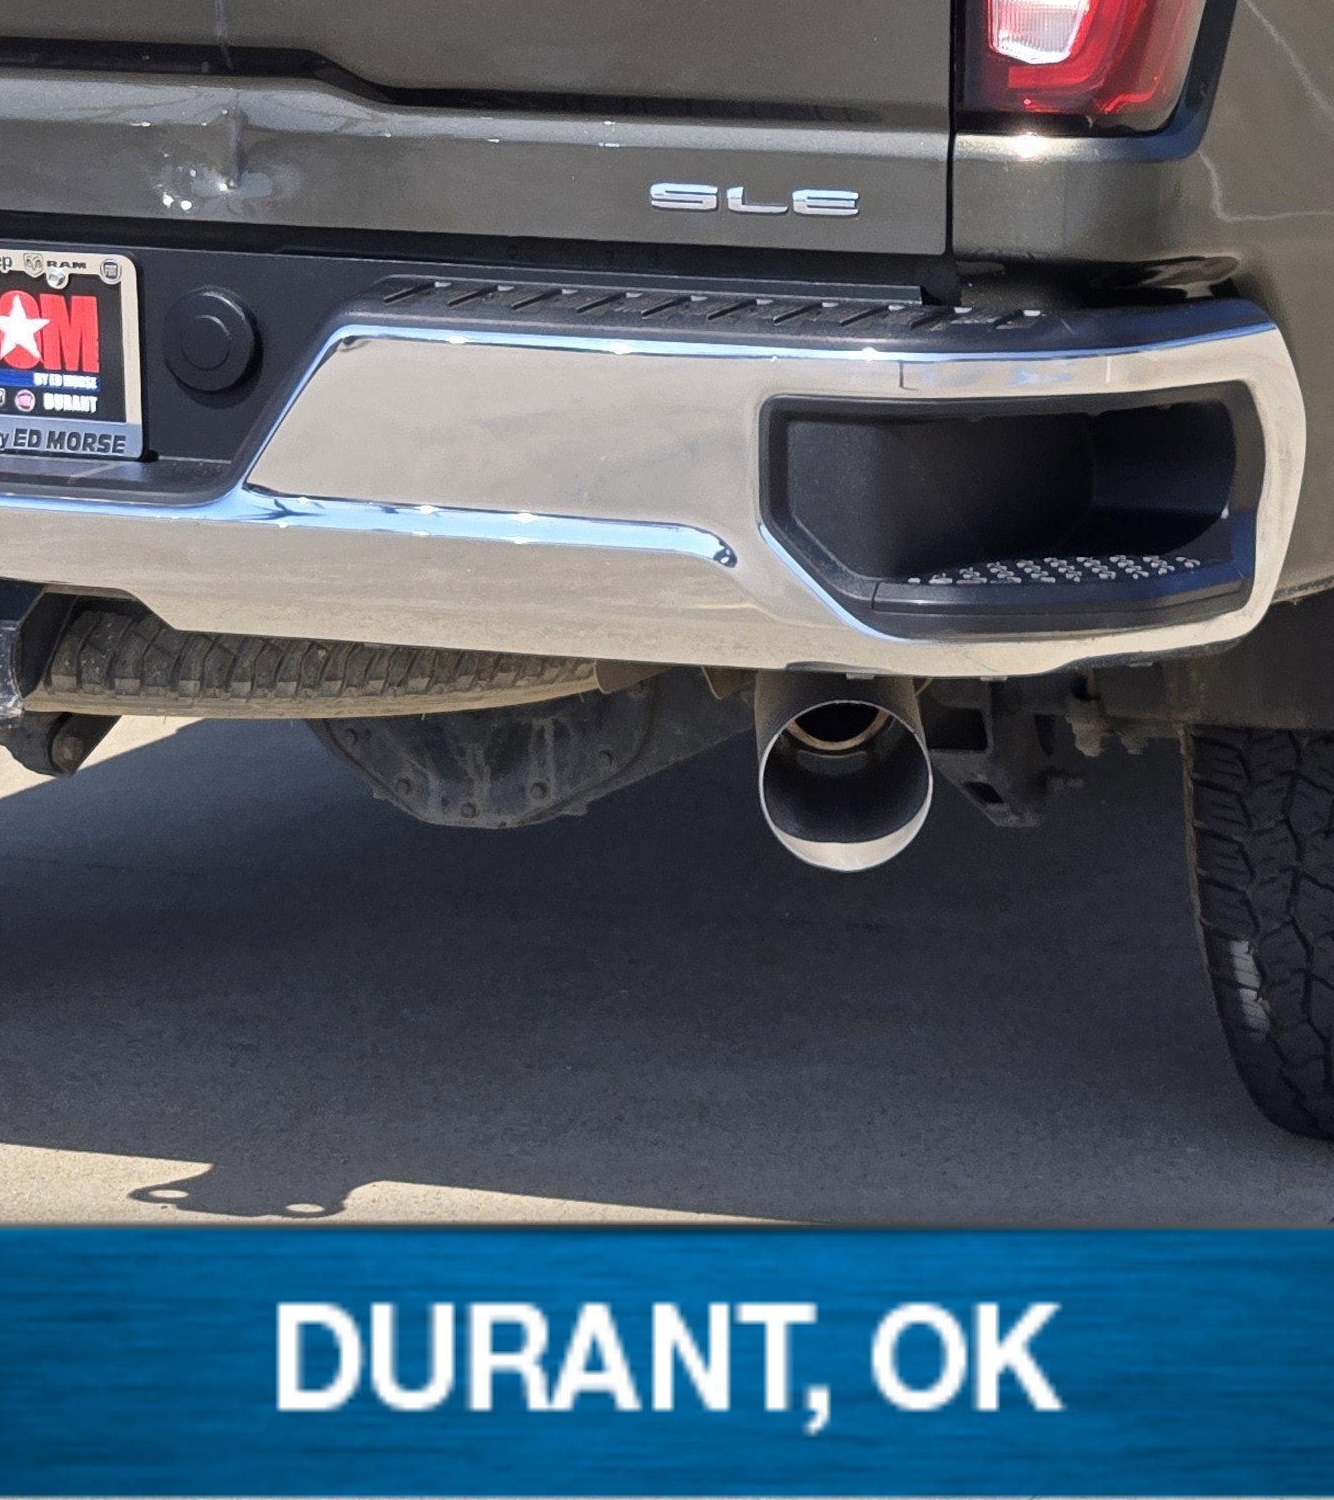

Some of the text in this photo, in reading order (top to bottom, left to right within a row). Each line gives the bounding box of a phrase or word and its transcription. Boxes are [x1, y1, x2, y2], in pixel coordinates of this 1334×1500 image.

[650, 182, 859, 216] SLE
[47, 260, 87, 269] RAM
[13, 428, 42, 448] ED
[46, 430, 127, 454] MORSE
